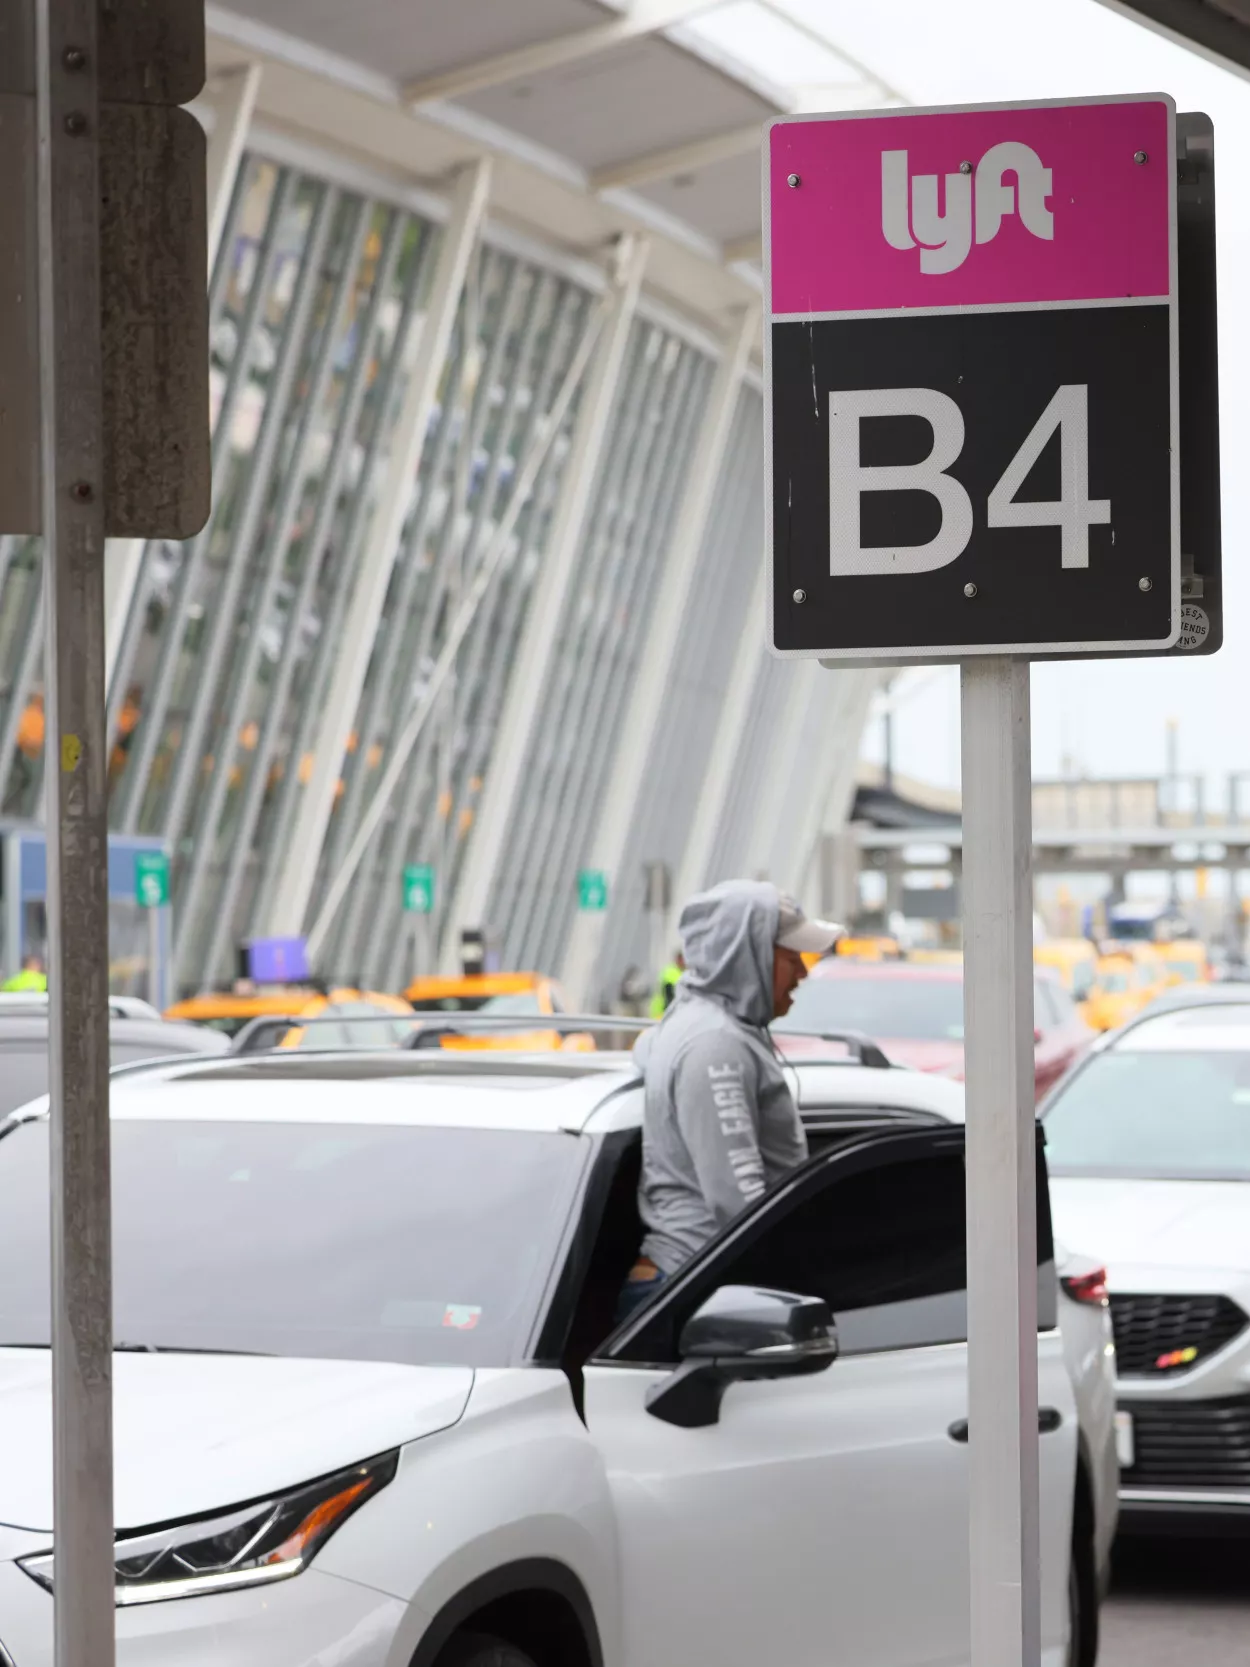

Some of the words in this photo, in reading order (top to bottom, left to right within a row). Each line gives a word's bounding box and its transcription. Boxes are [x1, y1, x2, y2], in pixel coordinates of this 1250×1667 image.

[881, 141, 1054, 275] lyft
[828, 383, 1111, 577] B4
[1177, 635, 1197, 646] ANG
[1180, 621, 1206, 635] IENDS
[708, 1063, 752, 1136] EAGLE
[727, 1146, 766, 1203] ICAN
